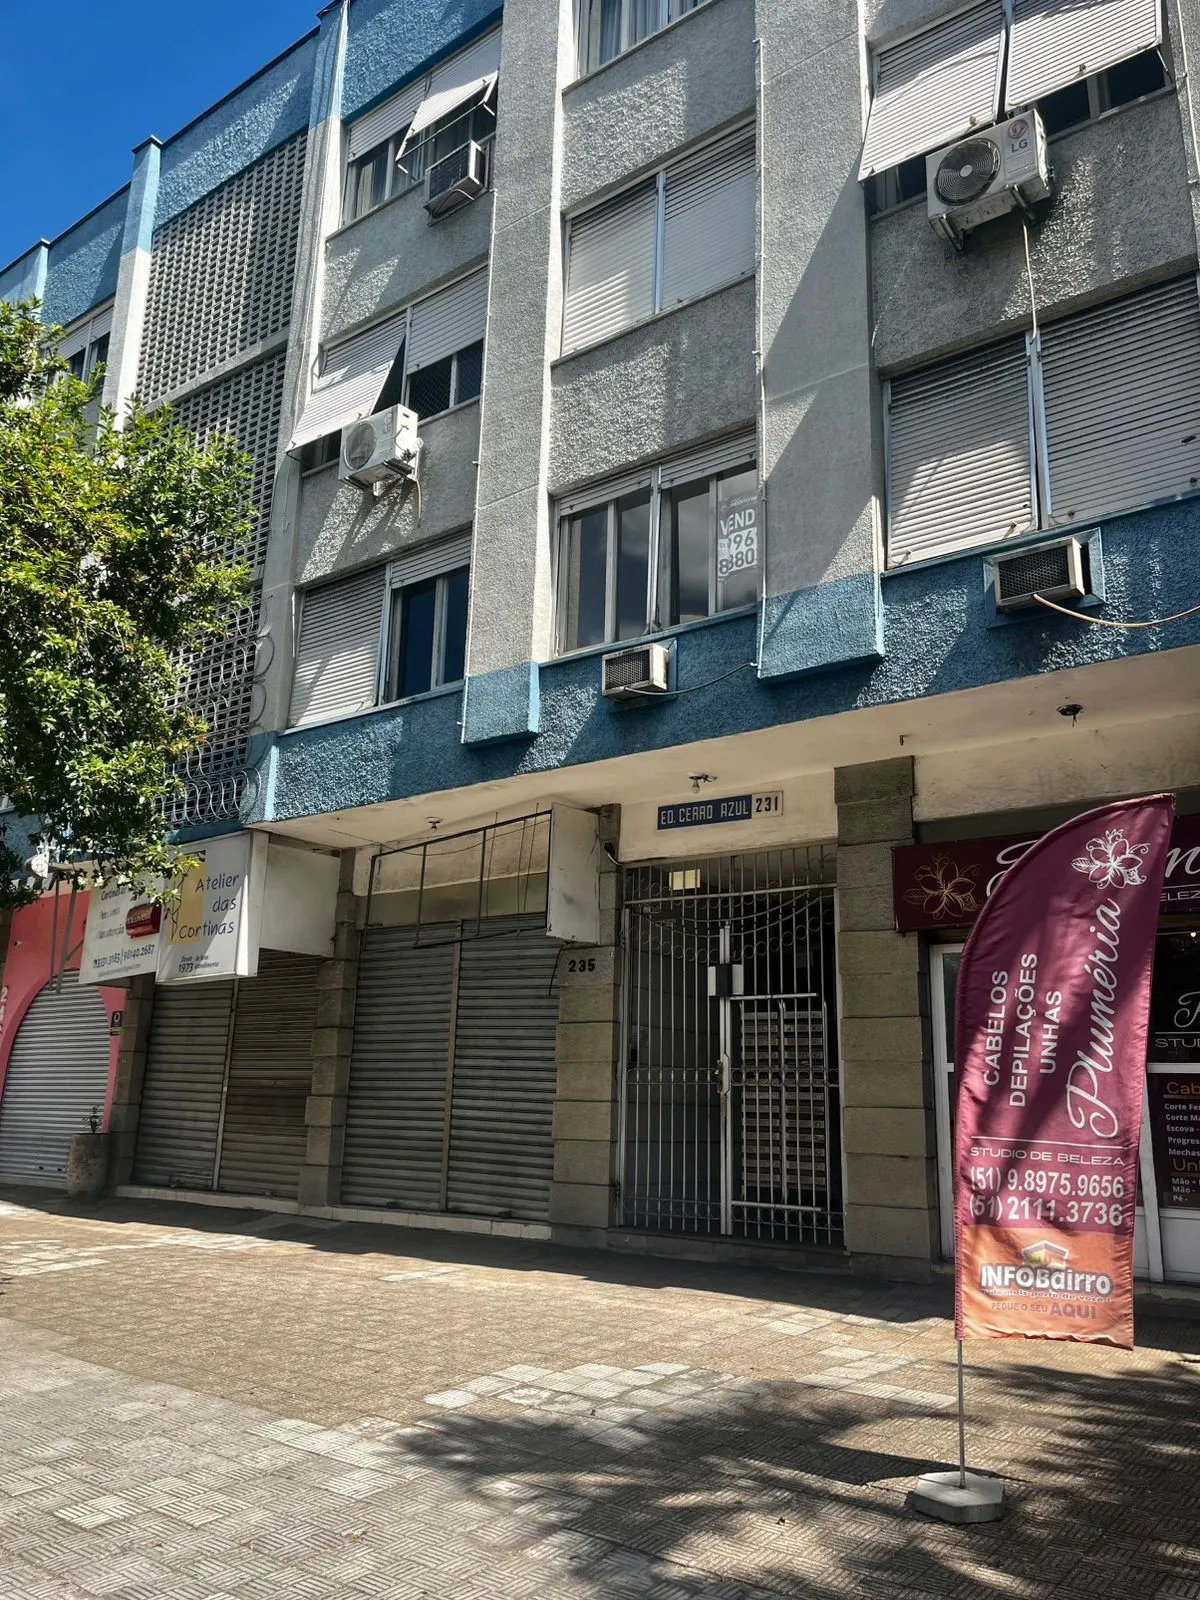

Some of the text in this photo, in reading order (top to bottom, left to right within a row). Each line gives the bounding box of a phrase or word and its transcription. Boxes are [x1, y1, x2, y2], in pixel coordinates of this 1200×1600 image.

[1011, 139, 1028, 153] LG
[660, 796, 779, 825] ED. CERRO AZUL 231
[195, 873, 239, 893] Atelier
[212, 896, 237, 913] das
[179, 921, 234, 939] Cortinas
[178, 962, 194, 974] 1973
[568, 958, 596, 973] 235
[1065, 898, 1121, 1138] Pluméria
[983, 970, 1009, 1086] CABELOS
[1009, 953, 1038, 1107] DEPILAÇÕES
[1039, 990, 1062, 1074] UNHAS
[1164, 1103, 1187, 1111] Corte
[1165, 1113, 1189, 1121] Corte
[1166, 1124, 1195, 1132] Escova
[970, 1147, 1125, 1167] STUDIO DE BELEZA
[1168, 1148, 1200, 1157] Mechas
[970, 1166, 1125, 1199] (51) 9.8975.9656
[969, 1194, 1123, 1227] (51) 2111.3736
[980, 1264, 1112, 1295] INFOBairro
[991, 1302, 1097, 1319] PEGUE O SEU AQUI
